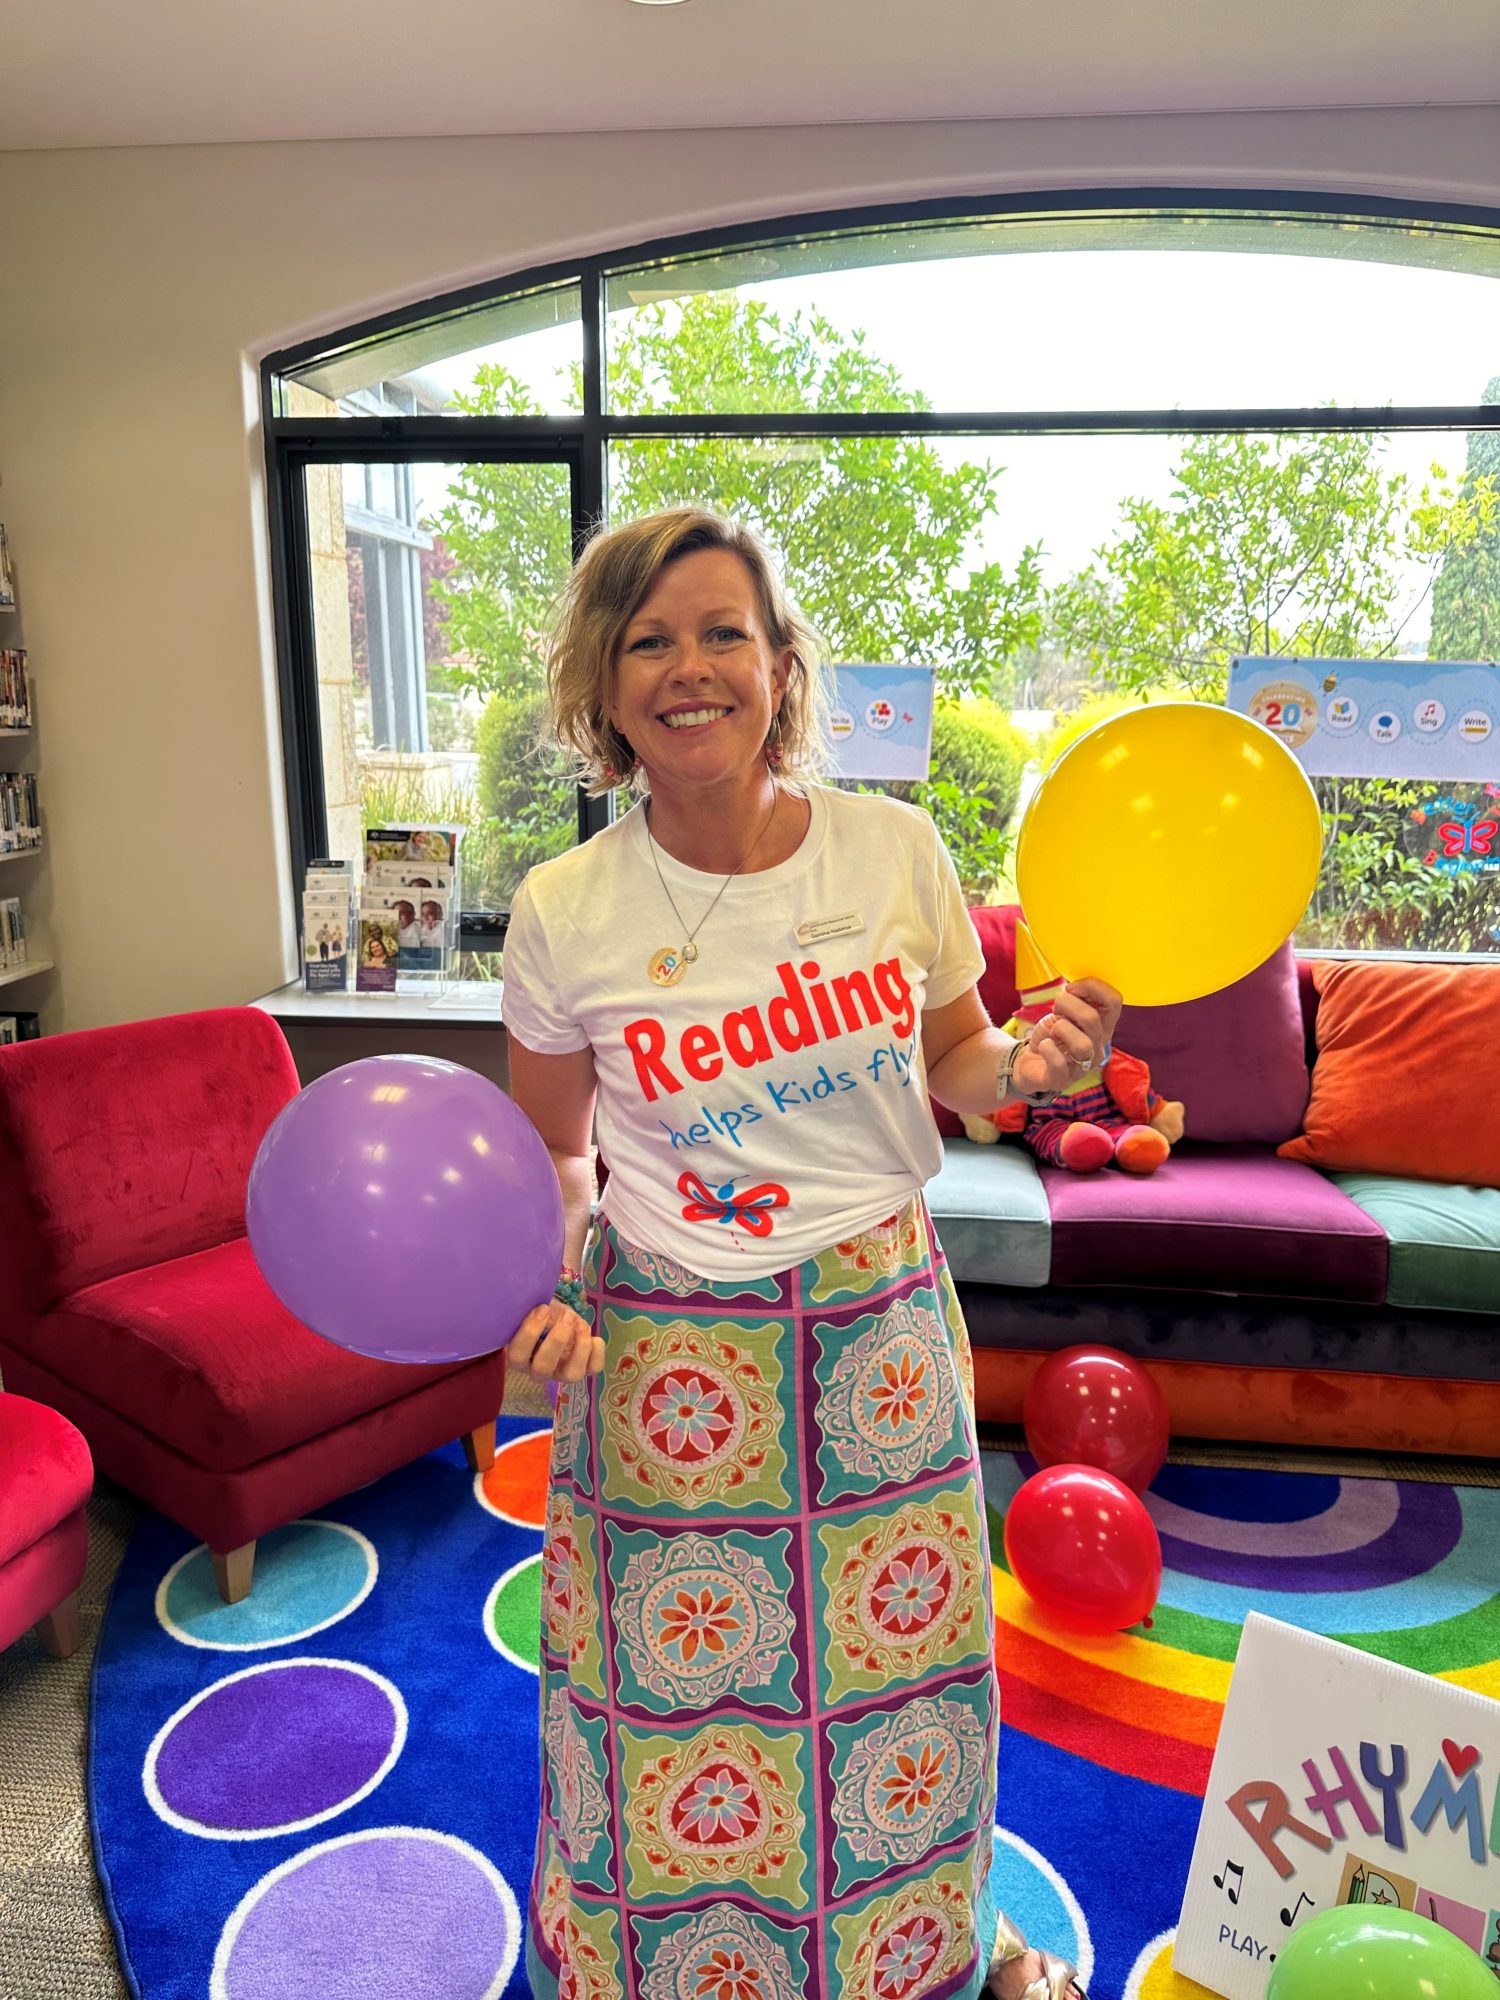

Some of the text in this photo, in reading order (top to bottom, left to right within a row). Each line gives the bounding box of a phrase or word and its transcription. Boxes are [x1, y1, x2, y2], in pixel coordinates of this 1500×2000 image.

[872, 716, 889, 727] Play
[1265, 703, 1300, 727] 20
[1332, 714, 1352, 723] Read
[1420, 717, 1438, 727] Sing
[1464, 717, 1487, 726] Write
[1376, 729, 1392, 738] Talk
[657, 955, 677, 977] 20
[624, 957, 915, 1103] Reading
[659, 1103, 763, 1150] helps
[1226, 1740, 1500, 1879] RHYM
